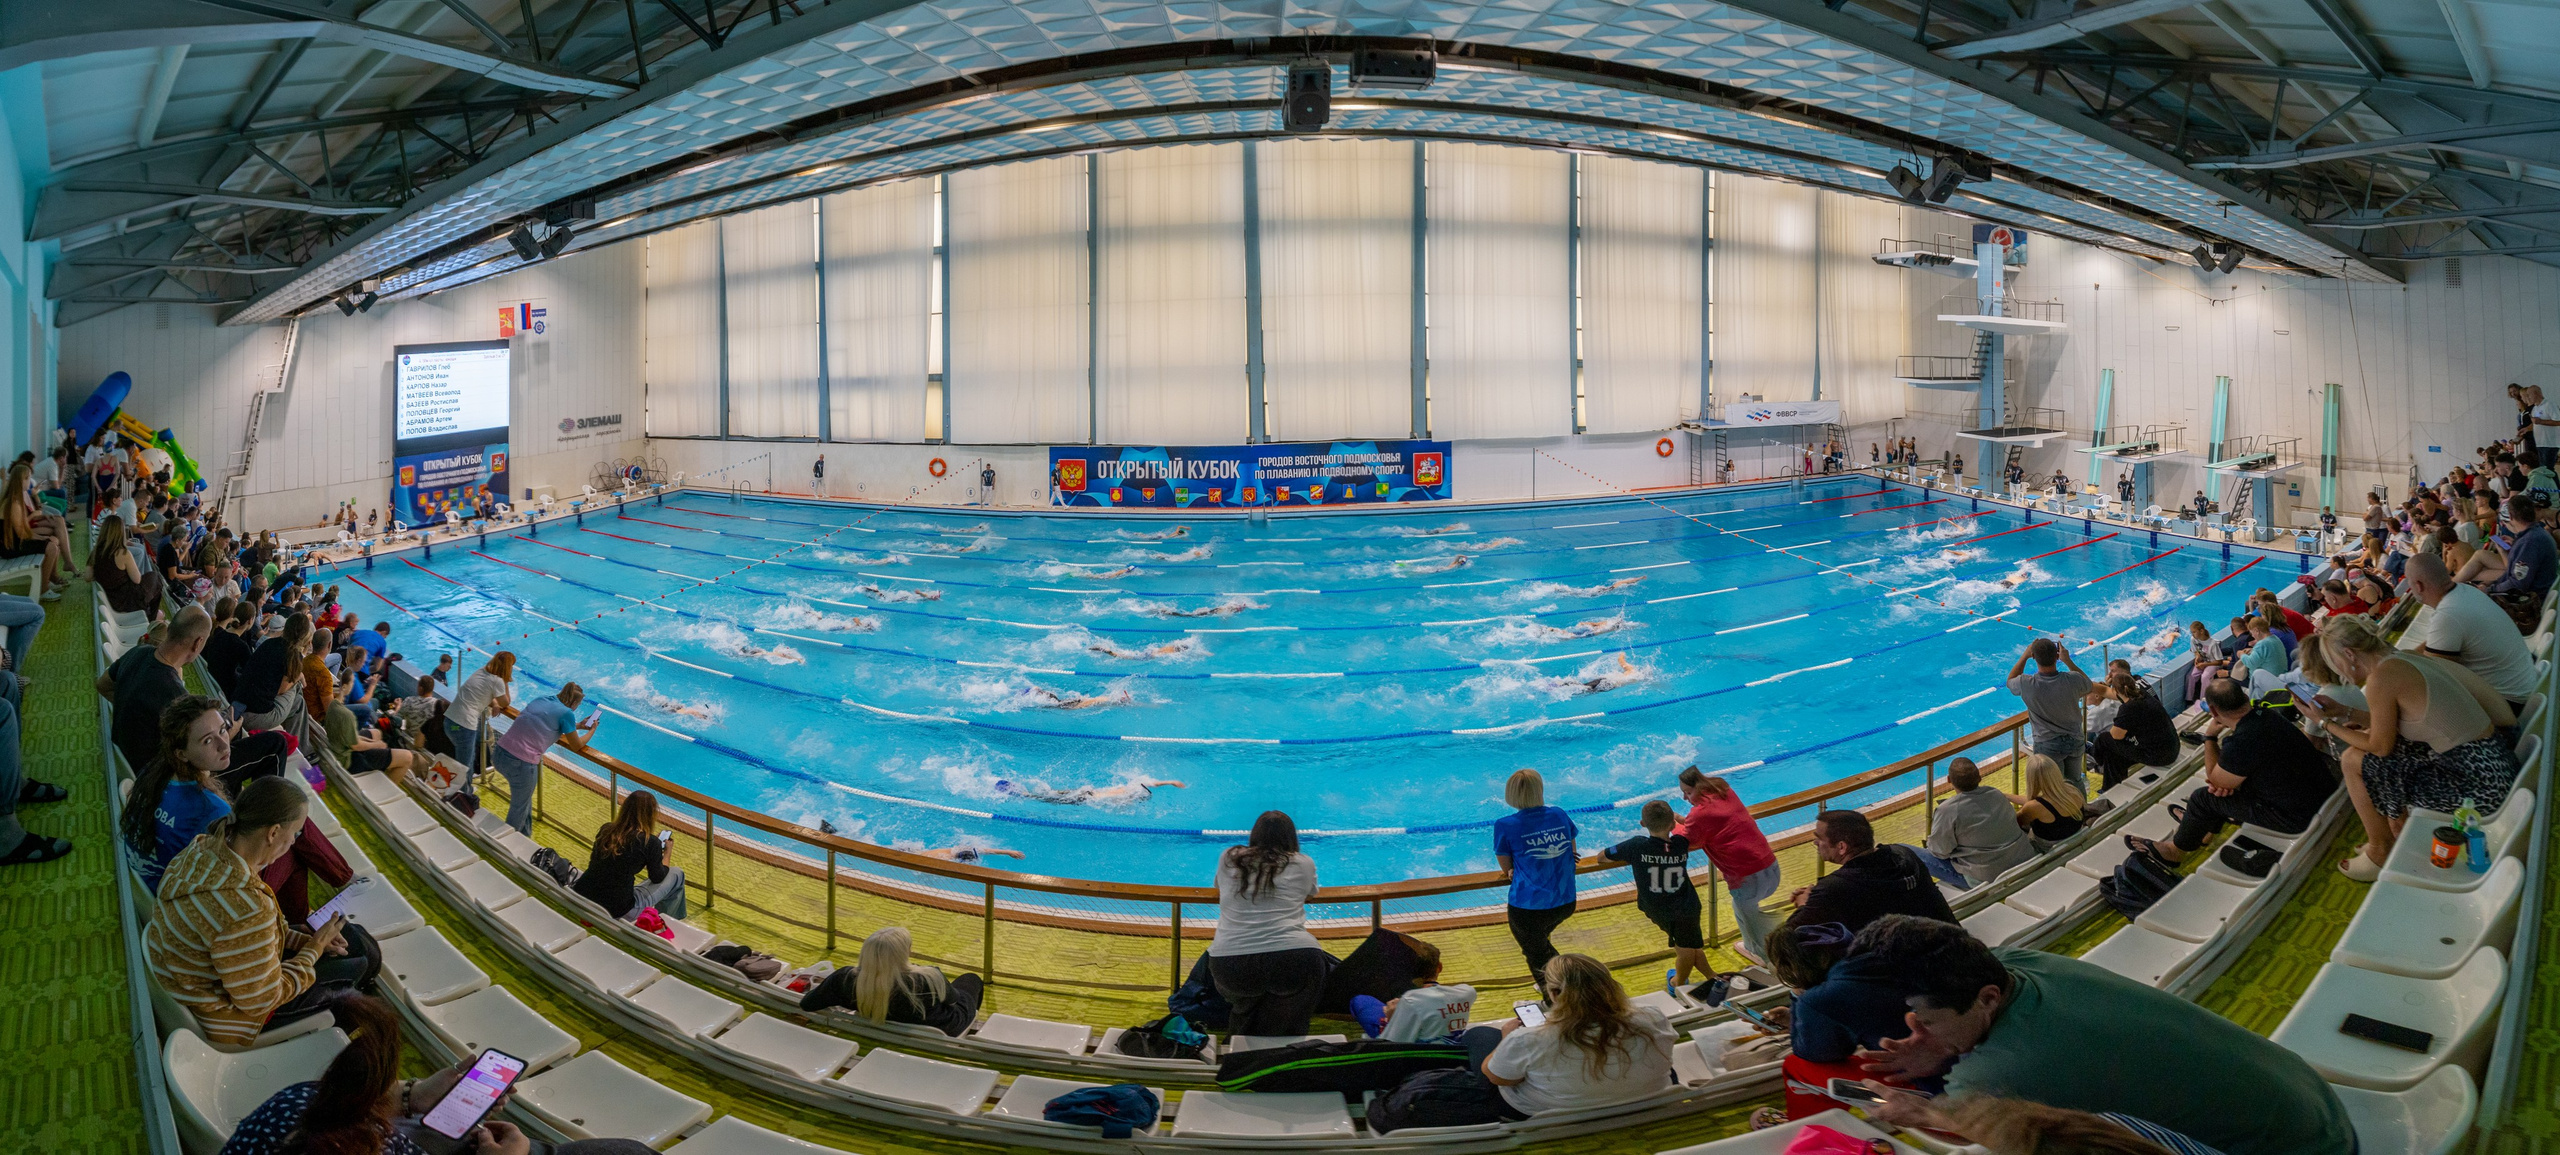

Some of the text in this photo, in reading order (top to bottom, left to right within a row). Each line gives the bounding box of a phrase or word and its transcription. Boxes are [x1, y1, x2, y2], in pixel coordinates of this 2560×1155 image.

[406, 364, 437, 373] ГАВРИЛОВ
[406, 373, 434, 381] АНТОНОВ
[406, 382, 430, 390] КАРПОВ
[406, 391, 434, 399] МАТВЕЕВ
[435, 389, 461, 397] Всеволод
[406, 400, 429, 408] БАЗЕЕВ
[430, 398, 459, 406] Ростислав
[439, 406, 460, 415] Георгий
[406, 417, 434, 426] АБРАМОВ
[577, 413, 622, 429] ЭЛЕМАШ
[405, 426, 427, 435] ПОПОВ
[428, 424, 458, 433] Владислав
[423, 453, 483, 471] ОТКРЫТЫЙ КУБОК
[1258, 452, 1401, 467] ГОРОДОВ ВОСТОЧНОГО ПОДМОСКОВЬЯ
[1097, 457, 1241, 479] ОТКРЫТЫЙ КУБОК
[1254, 465, 1405, 480] ПО ПЛАВАНИЮ И ПОДВОДНОМУ СПОРТУ
[154, 807, 176, 829] ОВА
[1526, 832, 1567, 847] ЧАЙКА
[1647, 866, 1685, 894] 10
[1448, 1018, 1468, 1032] СТЬ
